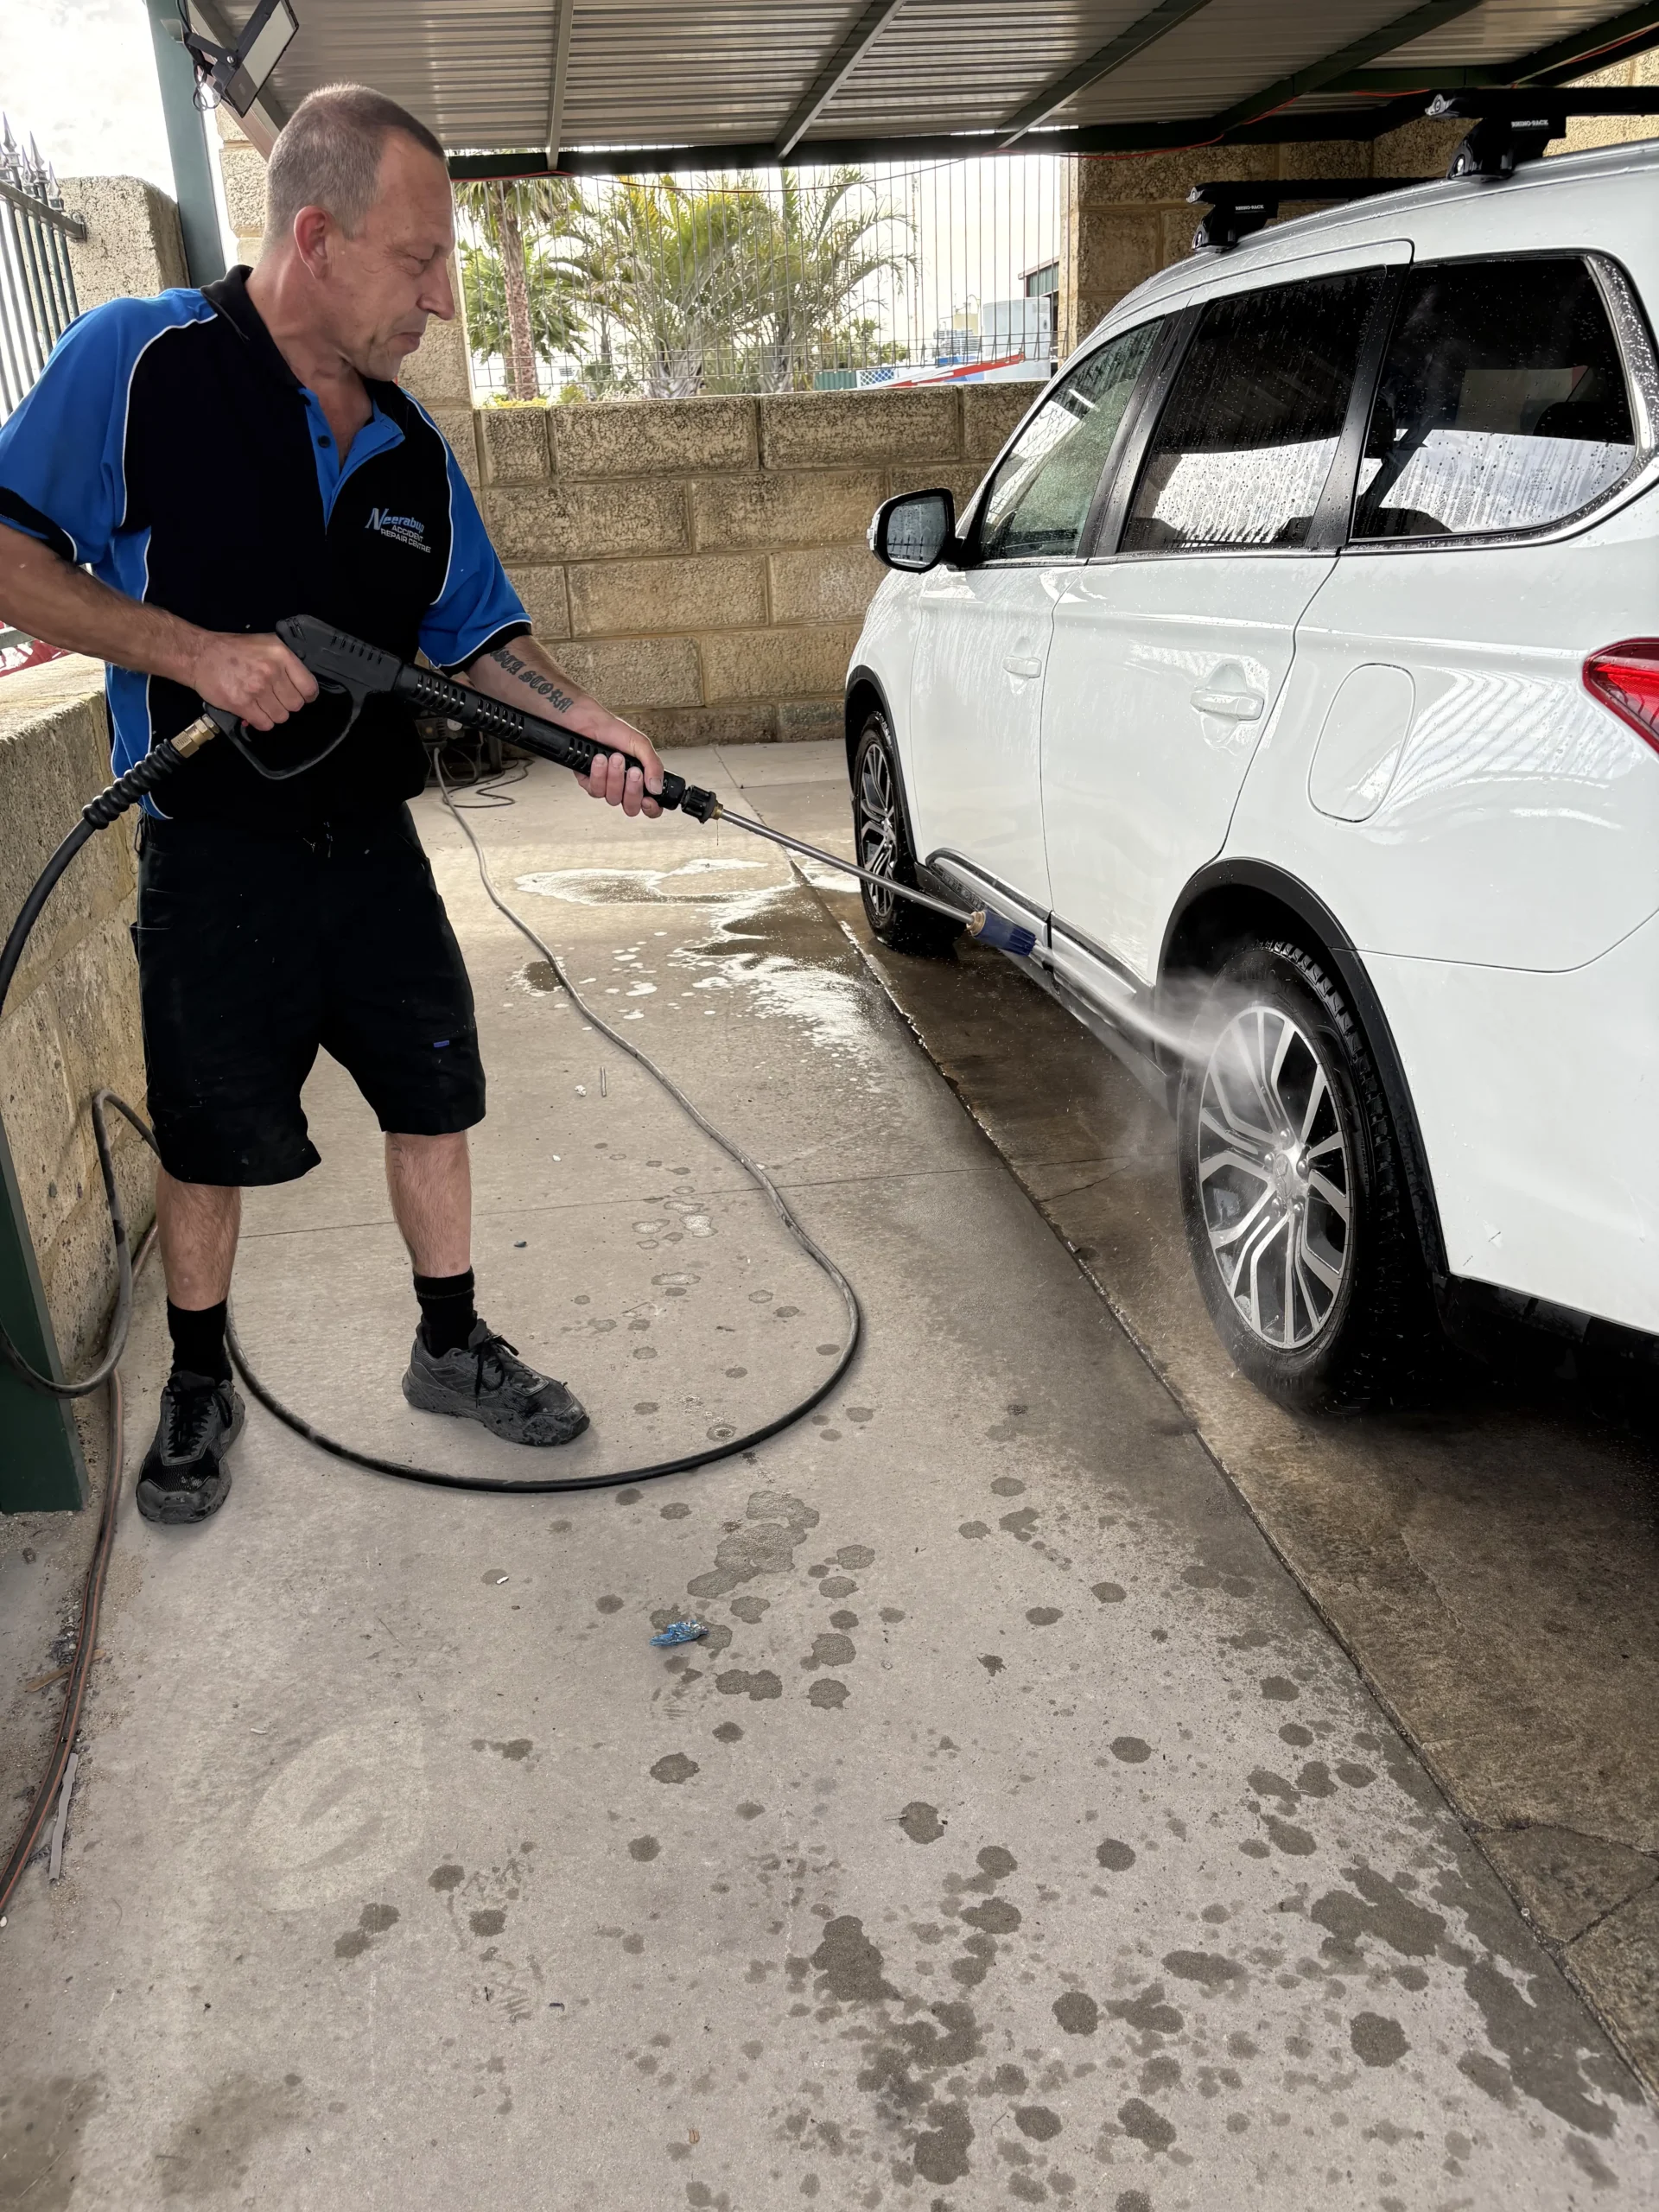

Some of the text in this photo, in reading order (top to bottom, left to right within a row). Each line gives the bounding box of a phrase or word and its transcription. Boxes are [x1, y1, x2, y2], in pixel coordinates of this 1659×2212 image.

[365, 507, 424, 534] Neerabup
[391, 524, 423, 542] ACCIDENT
[380, 528, 431, 553] REPAIR CENTRE
